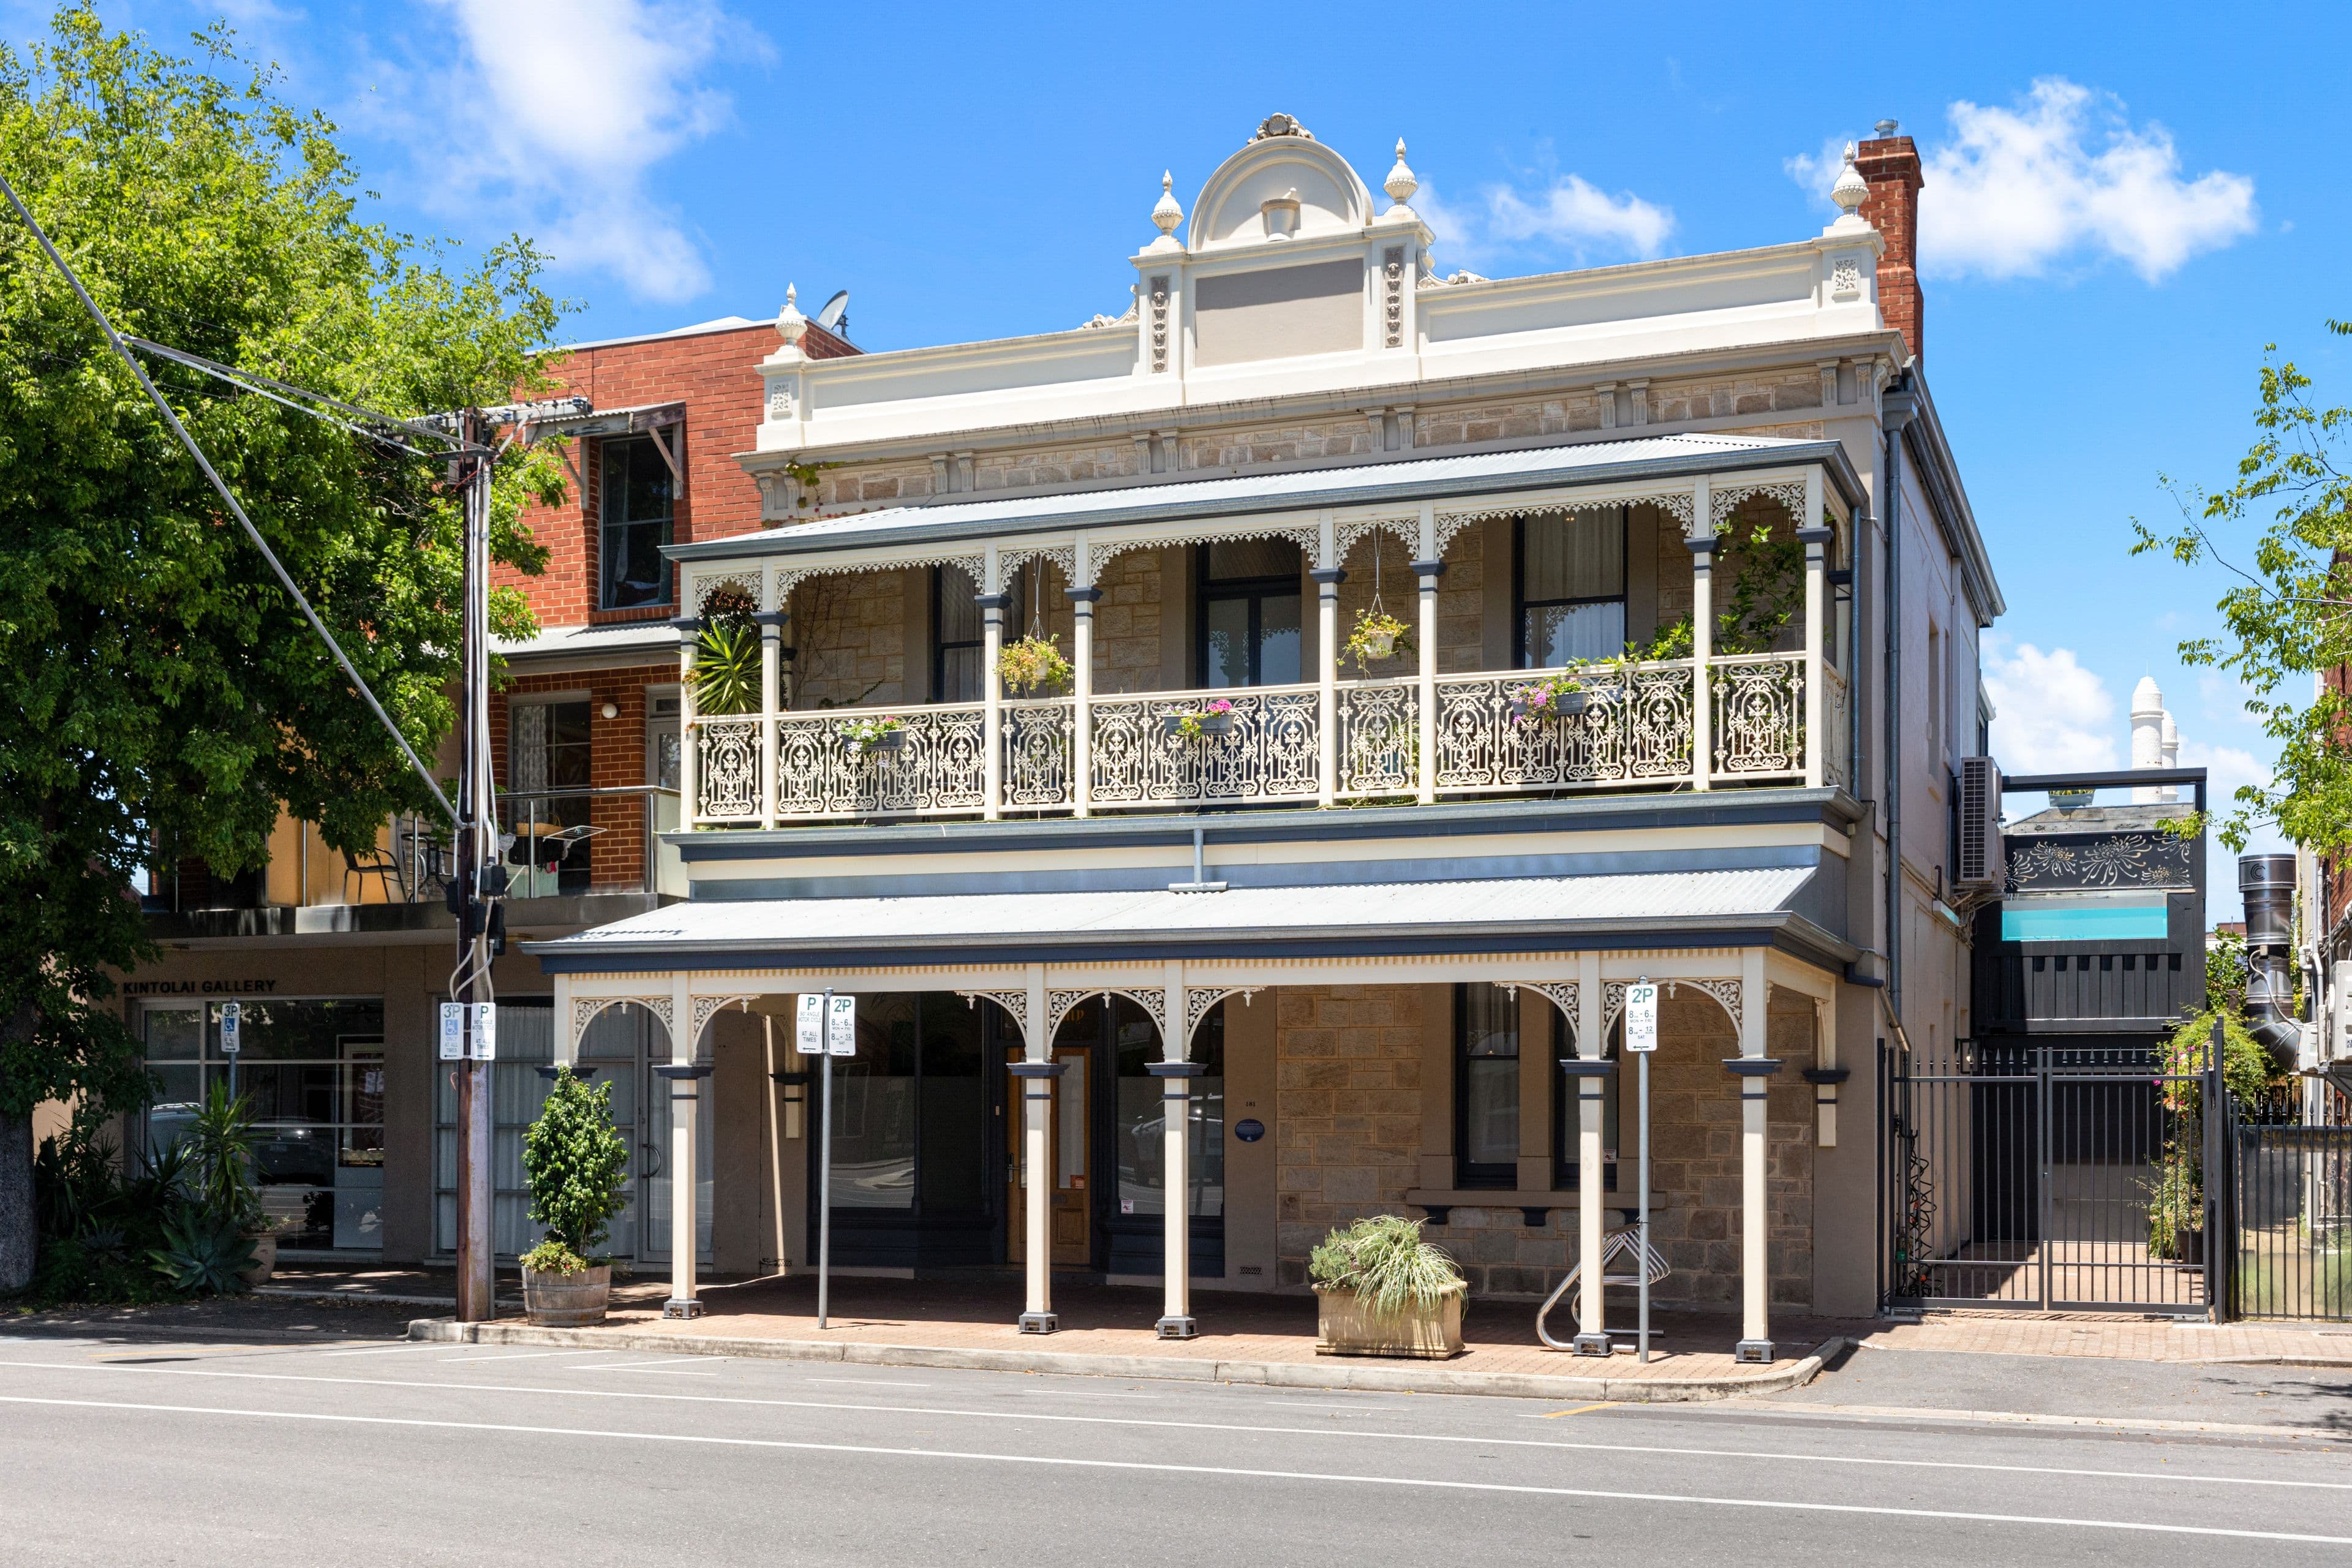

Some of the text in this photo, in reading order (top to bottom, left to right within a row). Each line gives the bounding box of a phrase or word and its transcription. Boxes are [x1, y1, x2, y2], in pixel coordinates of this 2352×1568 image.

[123, 979, 276, 994] KINTOLAI GALLERY
[1632, 988, 1654, 1003] 2P
[807, 997, 816, 1011] P
[834, 998, 851, 1012] 2P
[224, 1006, 238, 1017] 3P
[443, 1005, 461, 1018] 3P
[480, 1006, 489, 1019] P
